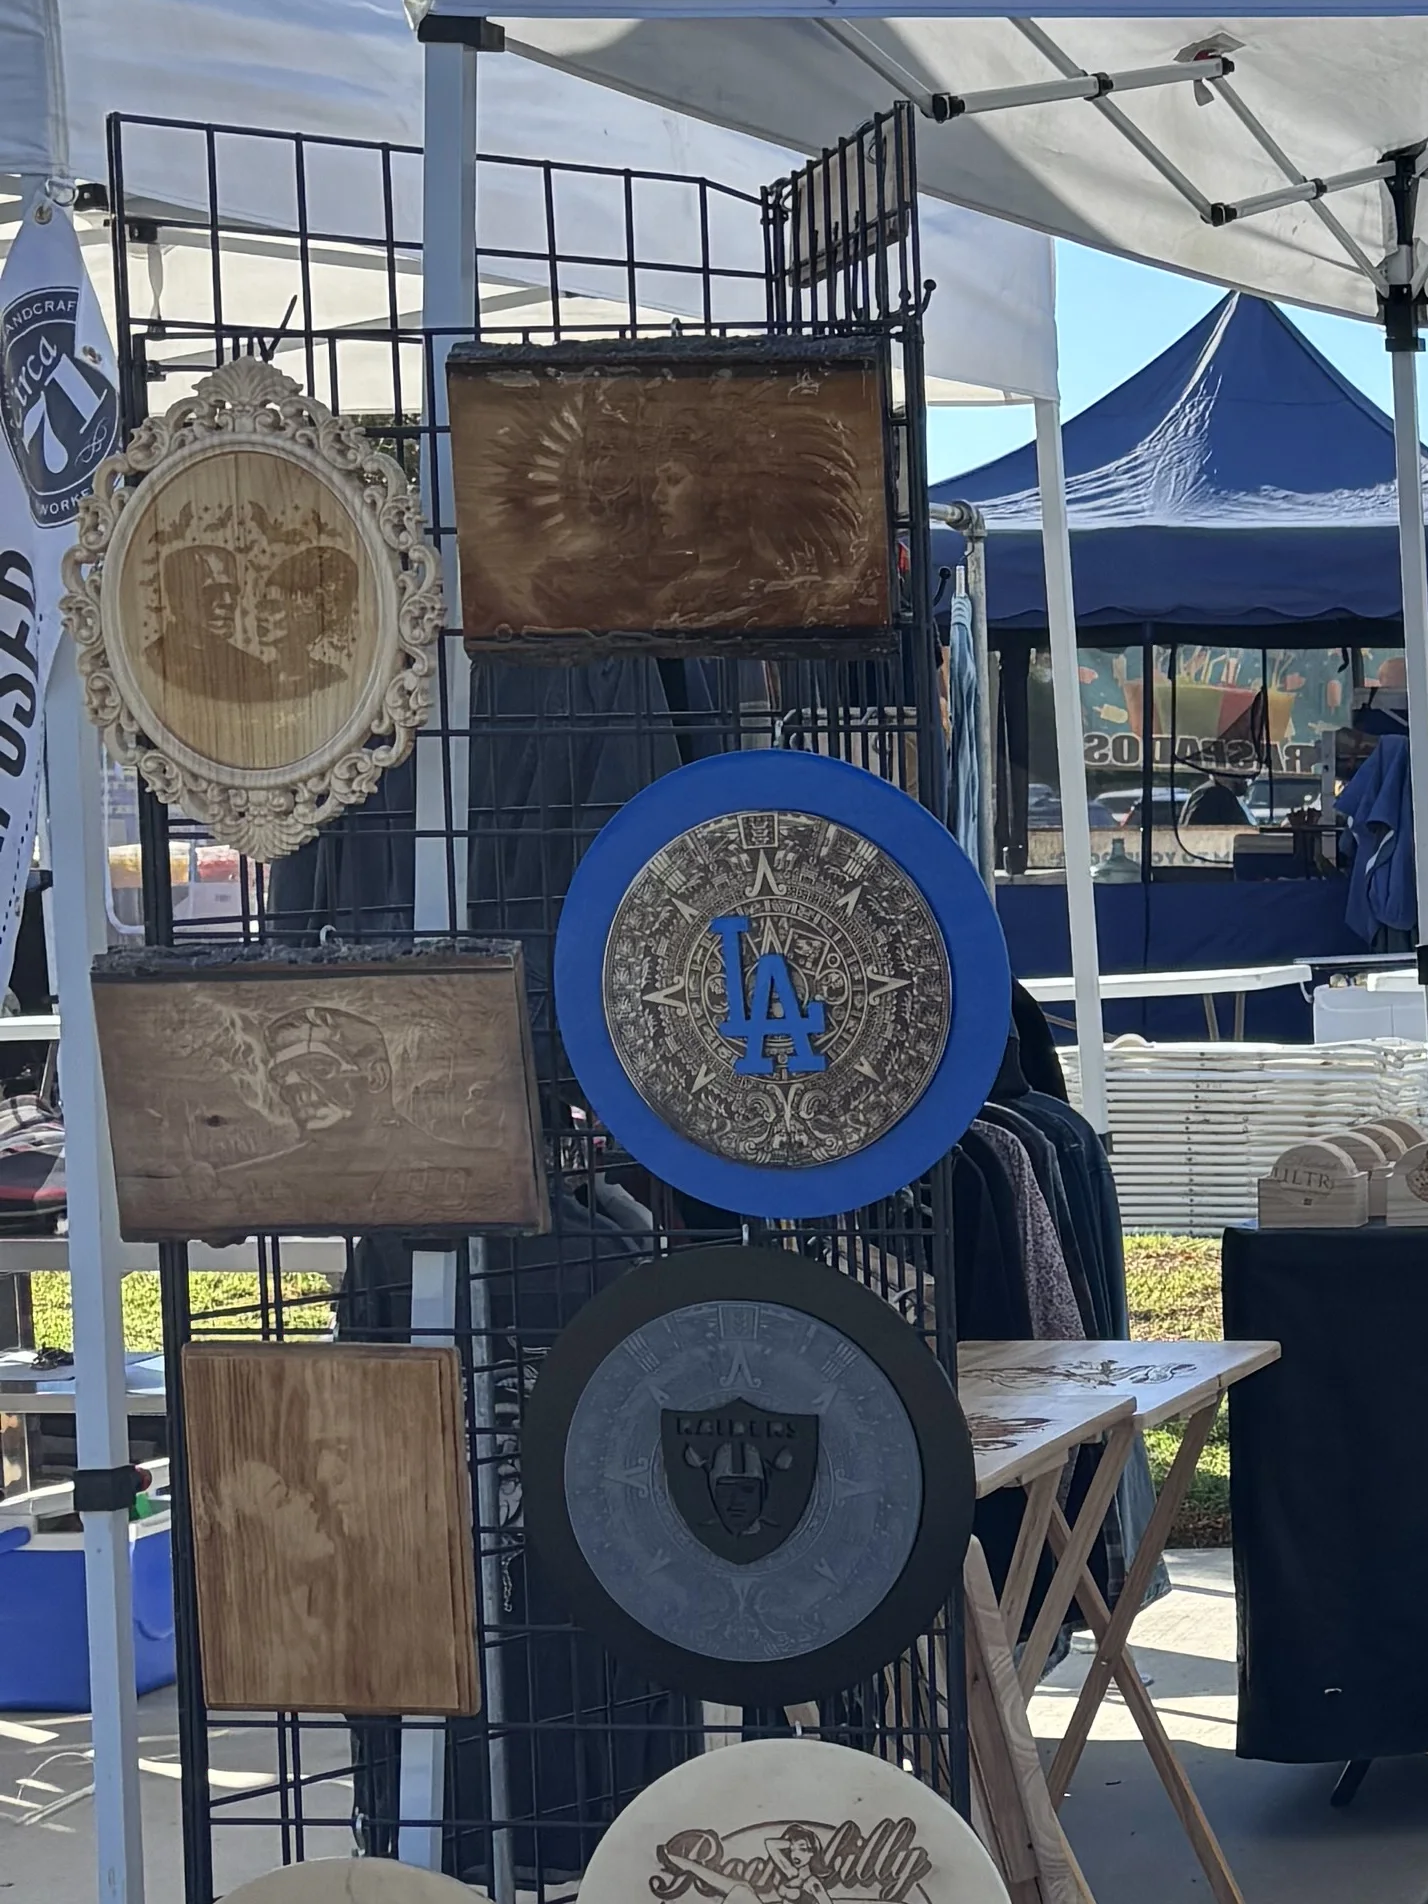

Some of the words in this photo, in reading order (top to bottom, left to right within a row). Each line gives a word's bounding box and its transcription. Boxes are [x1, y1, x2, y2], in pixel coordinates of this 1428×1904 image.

[4, 299, 78, 335] ANDCRAF
[23, 353, 108, 474] 71
[38, 487, 90, 516] WORKE
[708, 916, 828, 1075] LA
[676, 1416, 798, 1440] RAIDERS
